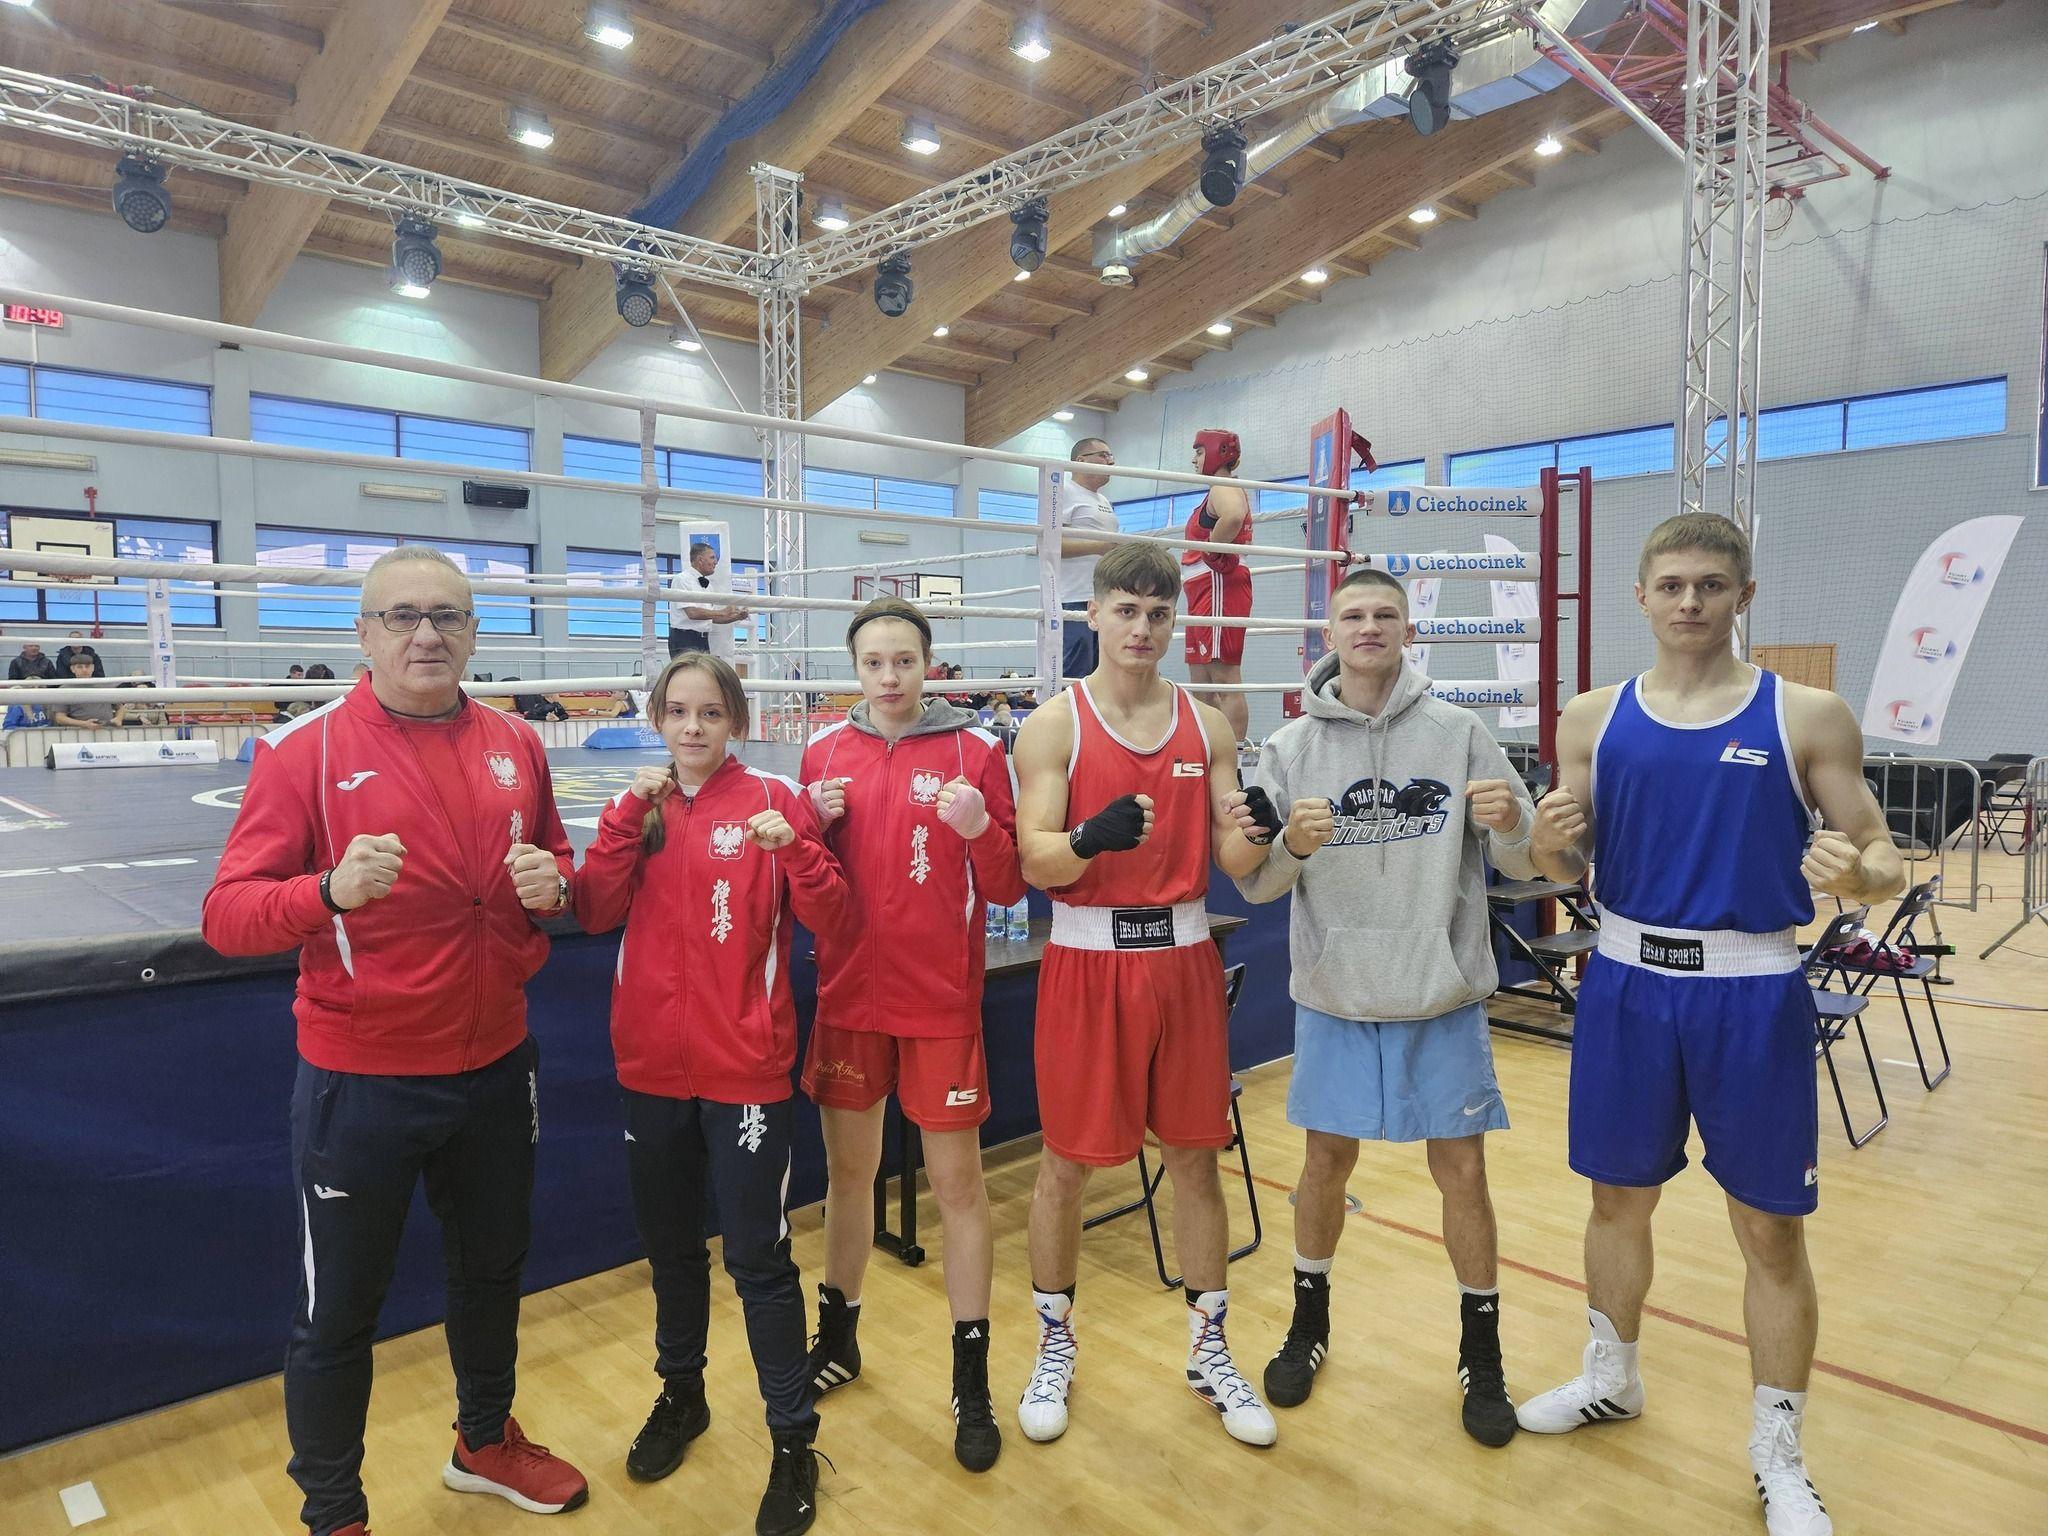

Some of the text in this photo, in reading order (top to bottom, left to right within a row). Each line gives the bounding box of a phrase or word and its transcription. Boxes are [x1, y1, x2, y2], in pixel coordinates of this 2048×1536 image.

[9, 304, 64, 328] 10:49
[1416, 495, 1528, 513] Ciechocinek
[1416, 553, 1527, 571] Ciechocinek
[1416, 618, 1526, 635] Ciechocinek
[1428, 687, 1524, 704] iechocinek
[1119, 918, 1168, 939] IHSAN SPORTS
[1668, 947, 1700, 965] SPORTS
